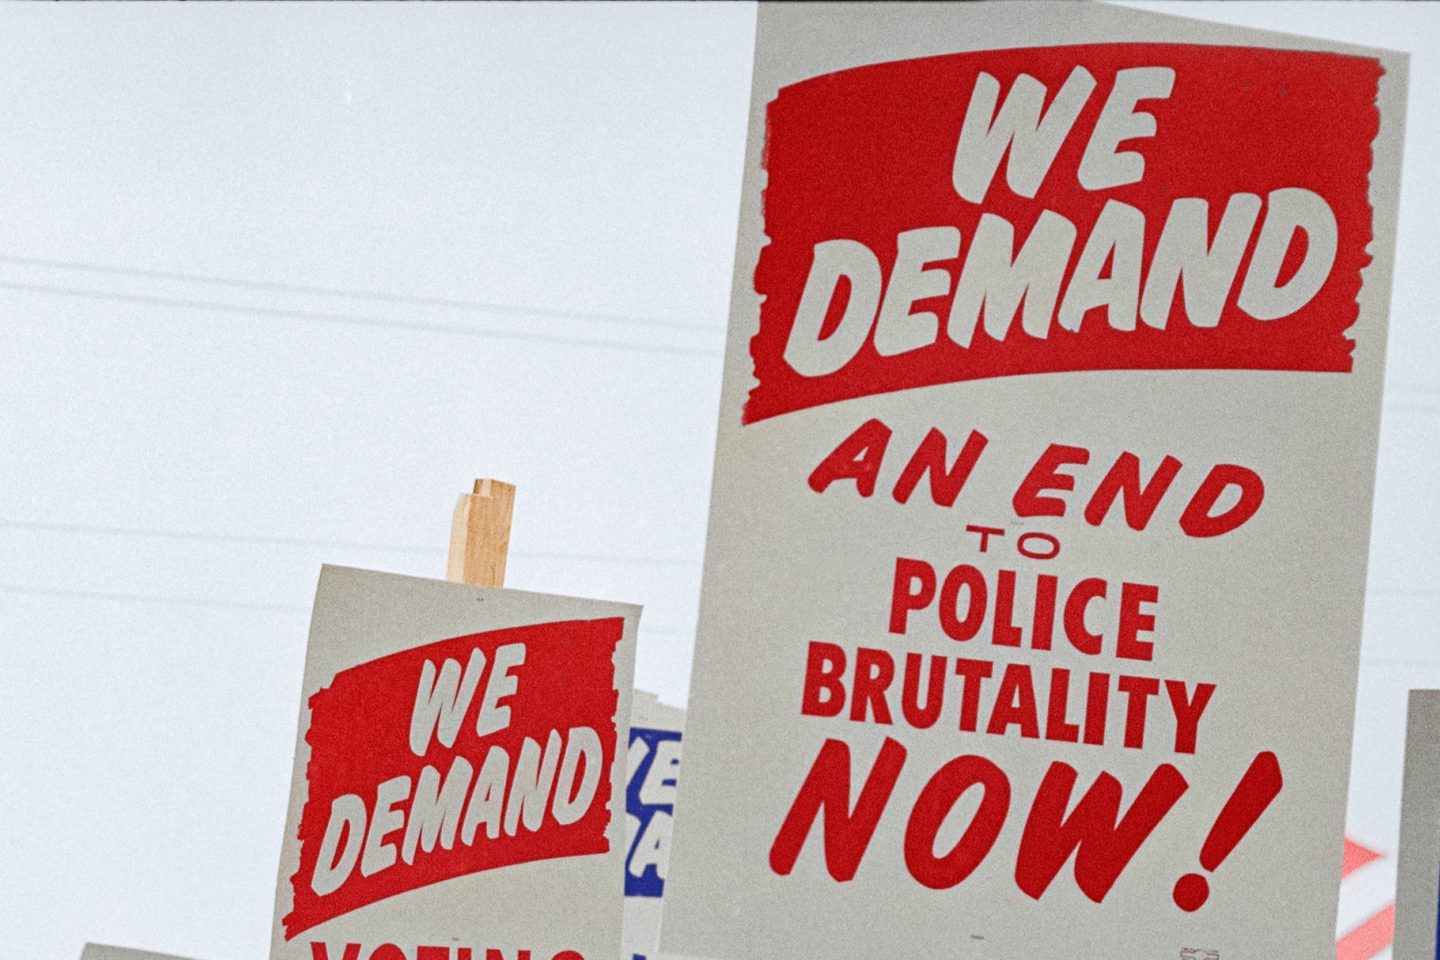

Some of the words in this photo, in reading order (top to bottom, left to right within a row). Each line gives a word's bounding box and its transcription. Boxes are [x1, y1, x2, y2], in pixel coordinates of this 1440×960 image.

[953, 64, 1176, 204] WE
[783, 187, 1338, 377] DEMAND
[807, 417, 989, 508] AN
[1013, 442, 1266, 538] END
[965, 524, 1061, 560] TO
[888, 556, 1160, 662] POLICE
[409, 642, 526, 758] WE
[801, 640, 1216, 755] BRUTALITY
[310, 725, 603, 899] DEMAND
[769, 735, 1283, 913] NOW!
